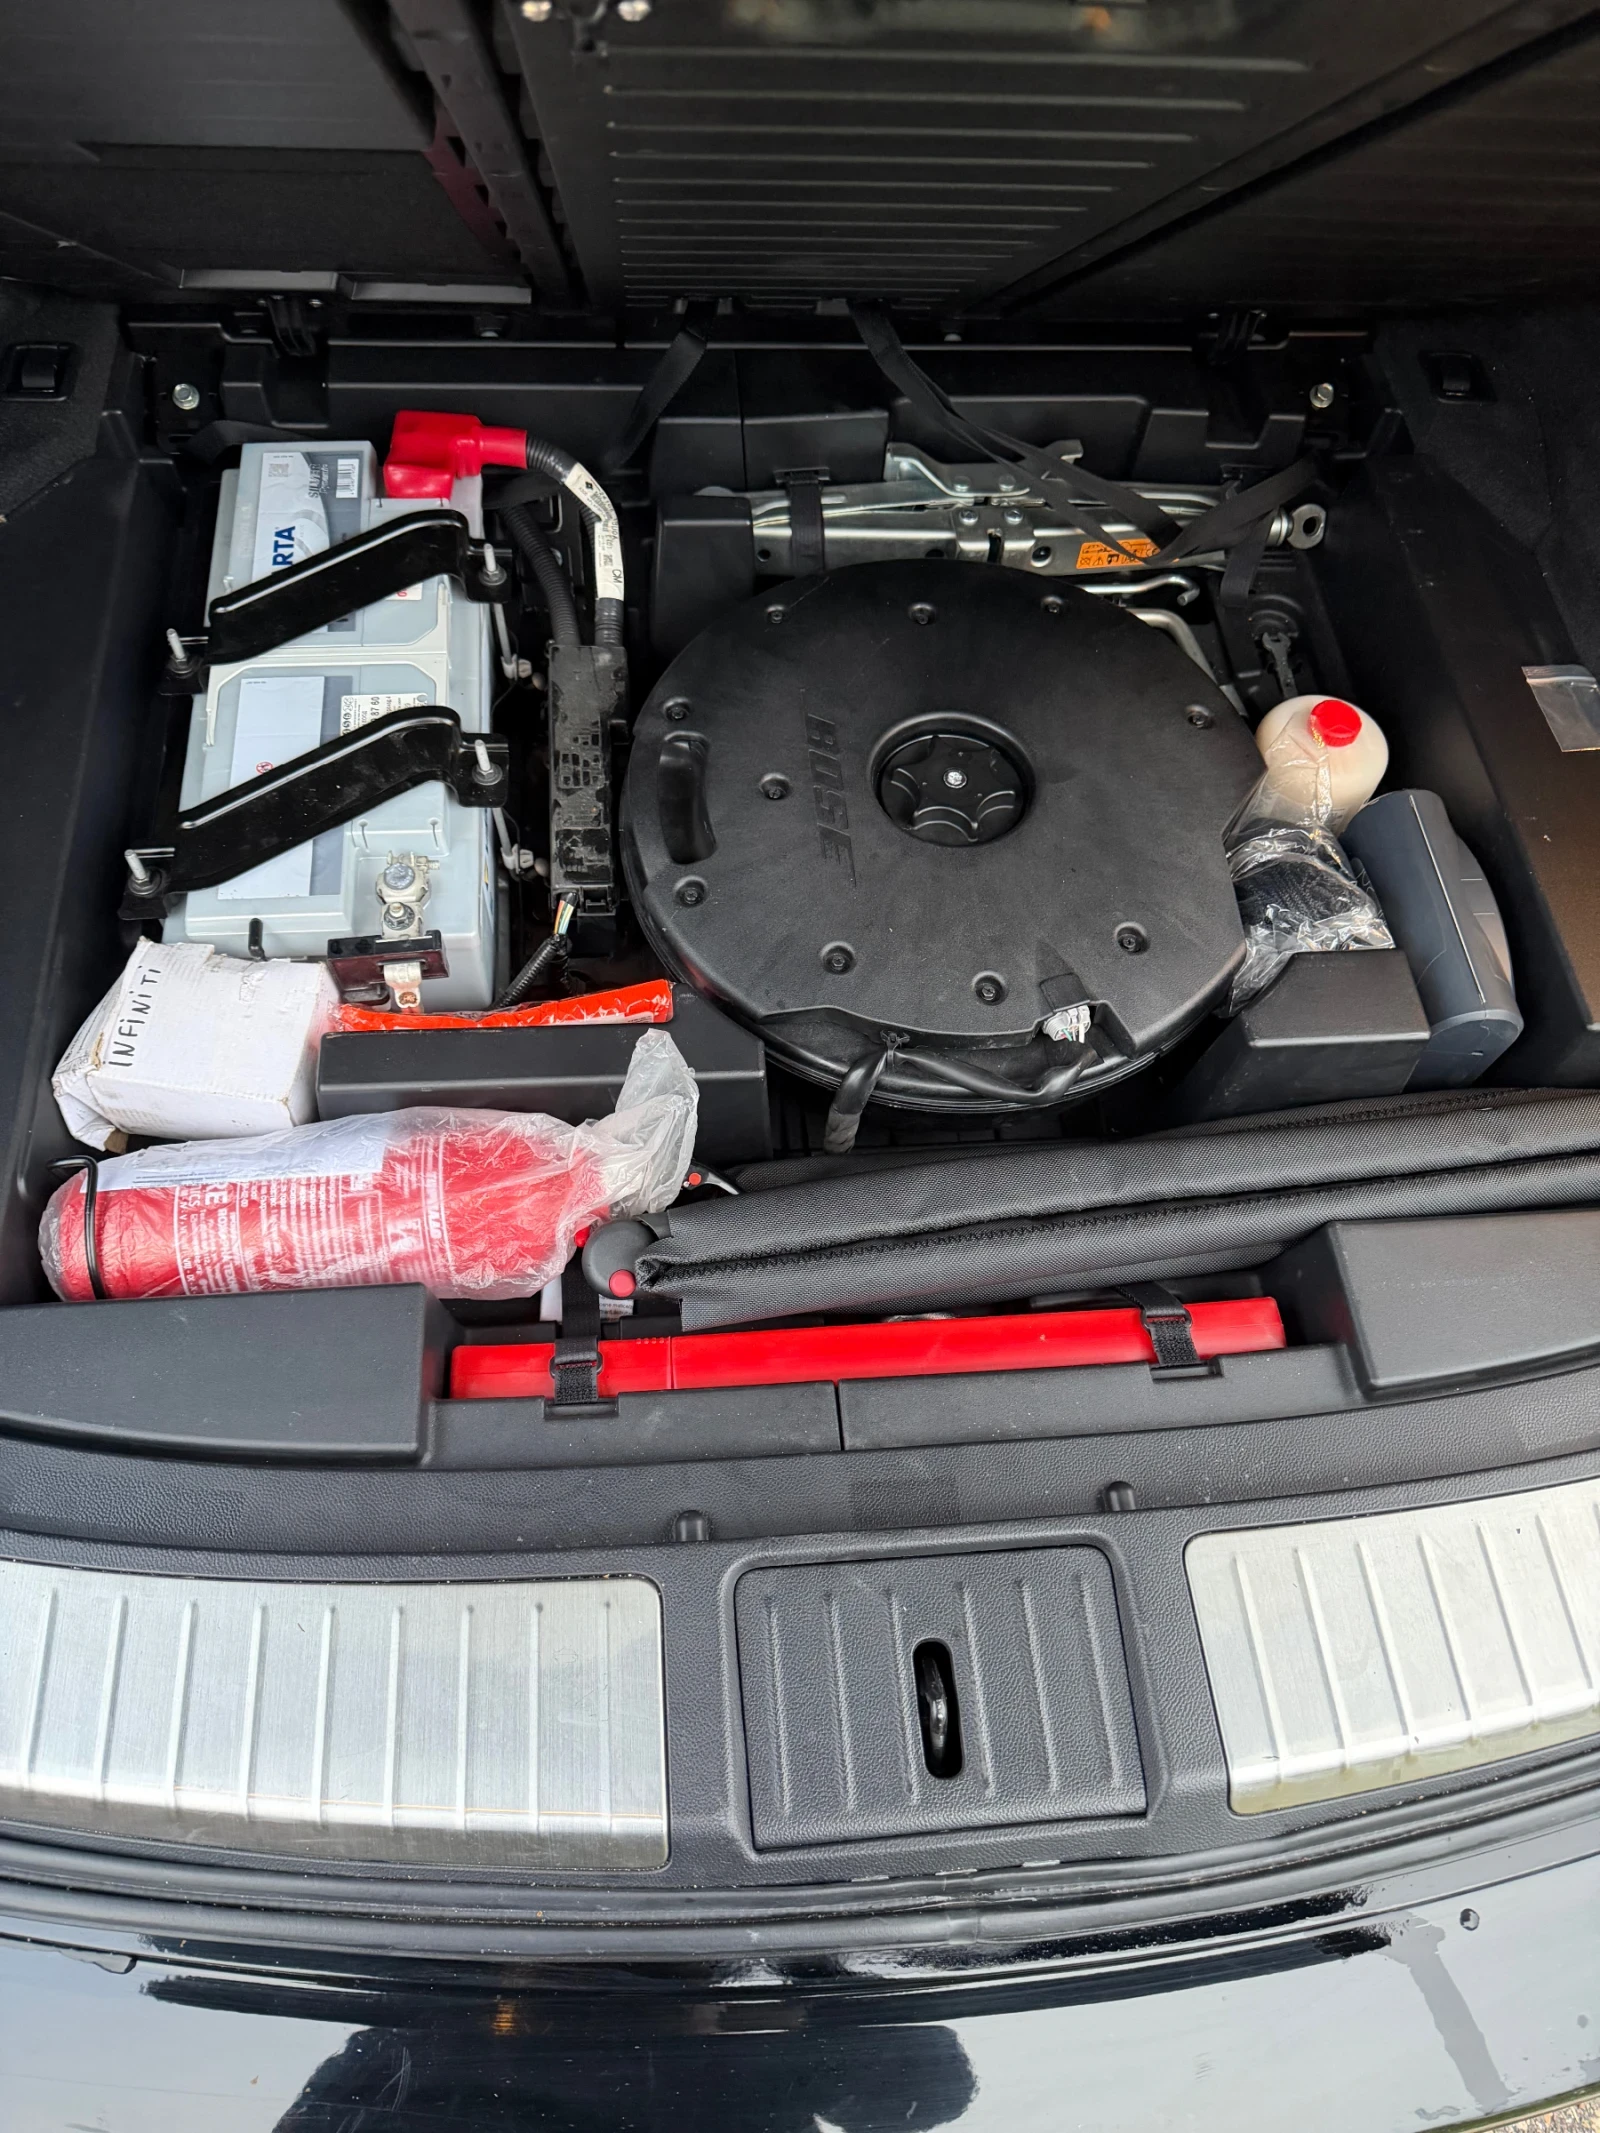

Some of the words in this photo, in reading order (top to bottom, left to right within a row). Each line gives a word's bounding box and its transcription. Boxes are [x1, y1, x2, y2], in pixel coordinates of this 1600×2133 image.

[308, 463, 321, 499] SILVER
[271, 525, 296, 567] RTA
[806, 698, 857, 888] BOSE
[204, 1182, 229, 1205] RE
